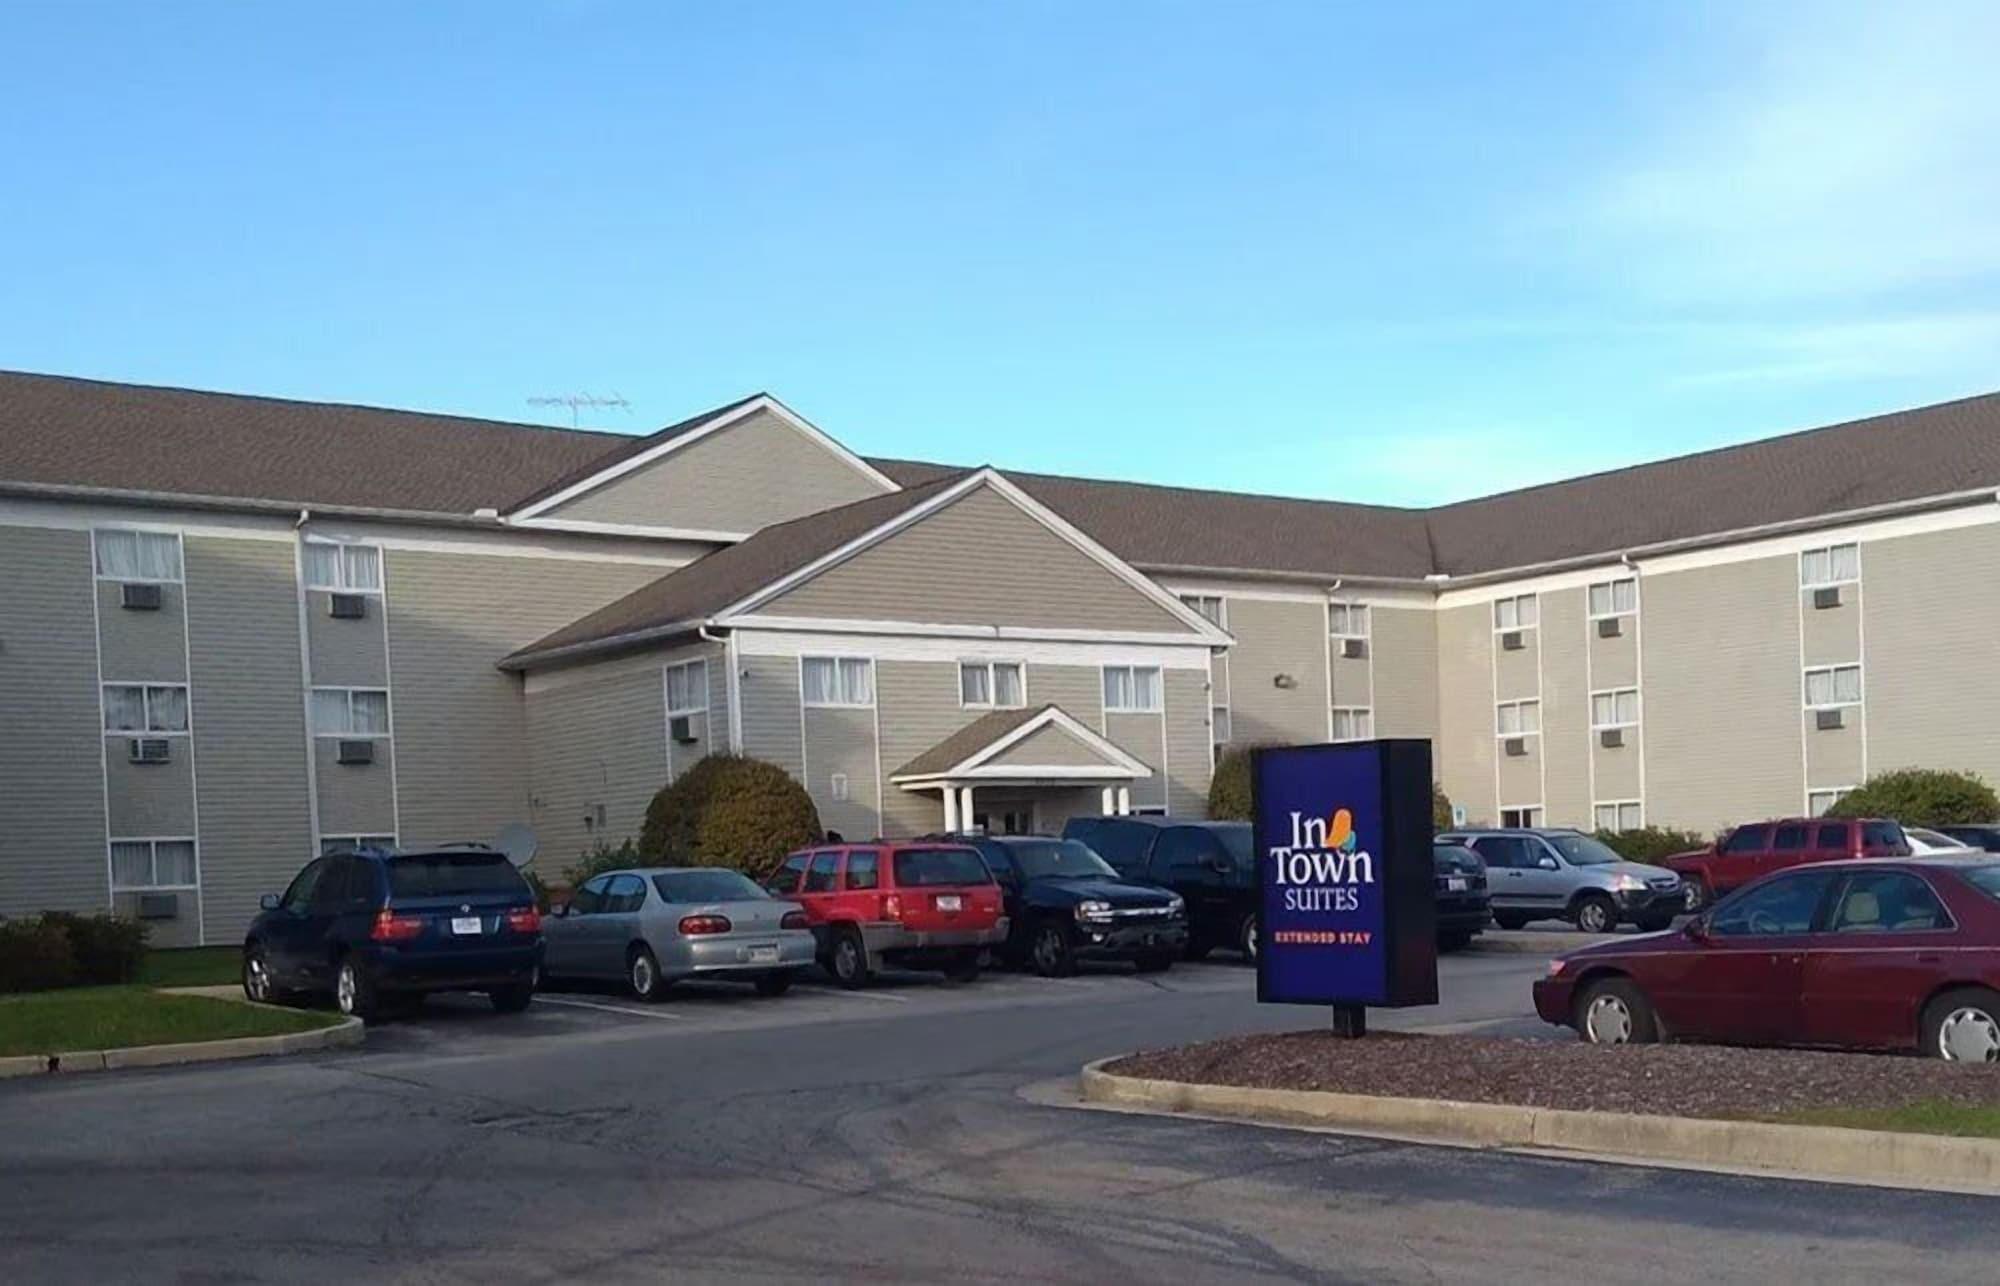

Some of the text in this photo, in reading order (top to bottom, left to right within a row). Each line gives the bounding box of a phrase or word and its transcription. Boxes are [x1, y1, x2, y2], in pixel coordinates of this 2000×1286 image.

[1290, 811, 1327, 850] In
[1270, 847, 1374, 885] Town
[1285, 887, 1359, 911] SUITES
[1275, 931, 1371, 944] EXTENDED STAY
